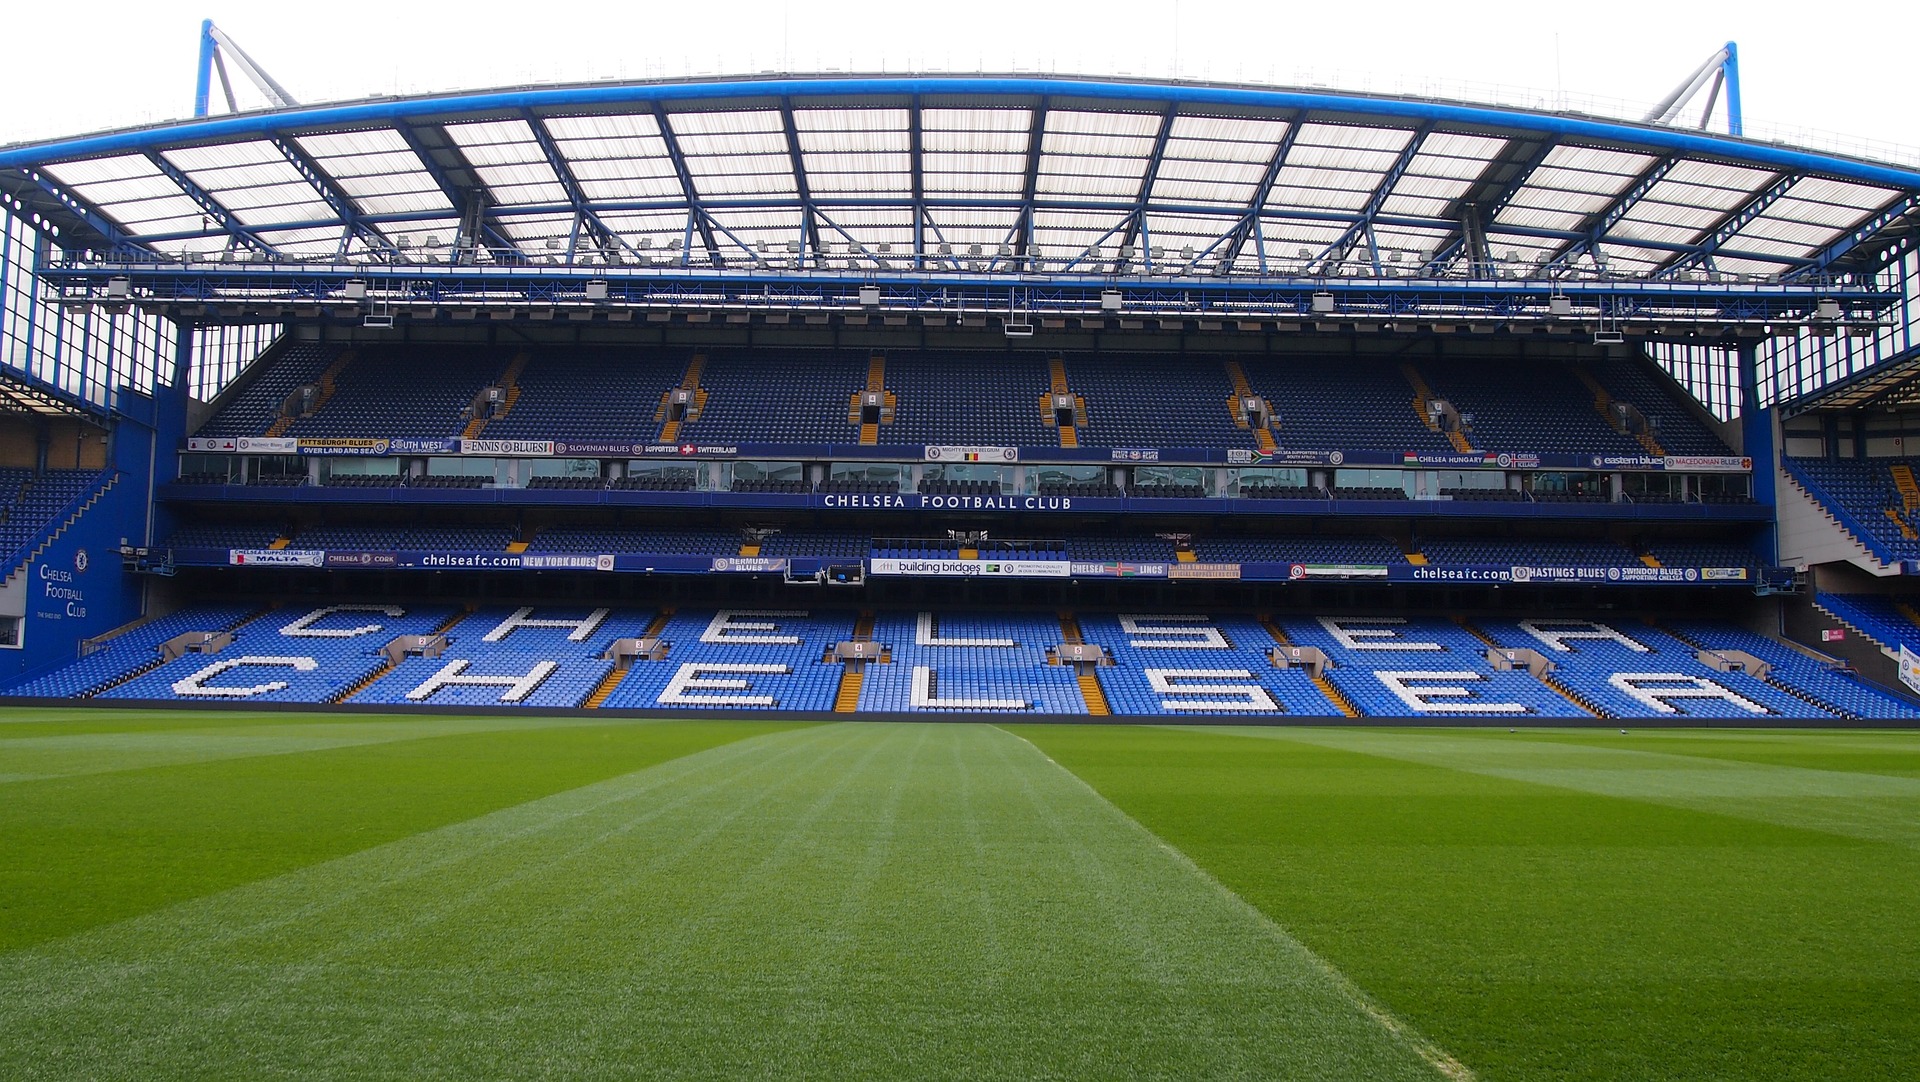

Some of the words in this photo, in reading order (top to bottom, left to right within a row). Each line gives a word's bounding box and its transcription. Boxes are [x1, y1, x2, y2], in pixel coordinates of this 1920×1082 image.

[420, 441, 443, 449] WEST
[471, 441, 500, 452] ENNIS
[513, 441, 544, 453] BLUES
[569, 444, 609, 452] SLOVENIAN
[645, 445, 679, 453] SUPPORTERS
[697, 446, 737, 454] SWITZERLAND
[1604, 456, 1639, 465] eastern
[1640, 455, 1664, 465] blues
[1720, 458, 1741, 466] BLUES
[824, 495, 905, 508] CHELSEA
[921, 496, 1017, 509] FOOTBALL
[1025, 497, 1071, 509] CLUB
[422, 554, 520, 566] chelseafc.com
[523, 556, 543, 567] NEW
[545, 556, 569, 567] YORK
[570, 557, 597, 567] BLUES
[729, 557, 769, 565] BERMUDA
[40, 563, 73, 582] CHELSEA
[899, 561, 941, 573] building
[942, 562, 981, 574] bridges
[1071, 564, 1104, 573] CHELSEA
[1139, 565, 1163, 574] LINCS
[1621, 567, 1658, 575] SWINDON
[1413, 567, 1510, 579] chelseafc.com
[1529, 568, 1575, 577] HASTINGS
[1577, 568, 1605, 578] BLUES
[46, 582, 83, 601] FOOTBALL
[66, 601, 87, 618] CLUB
